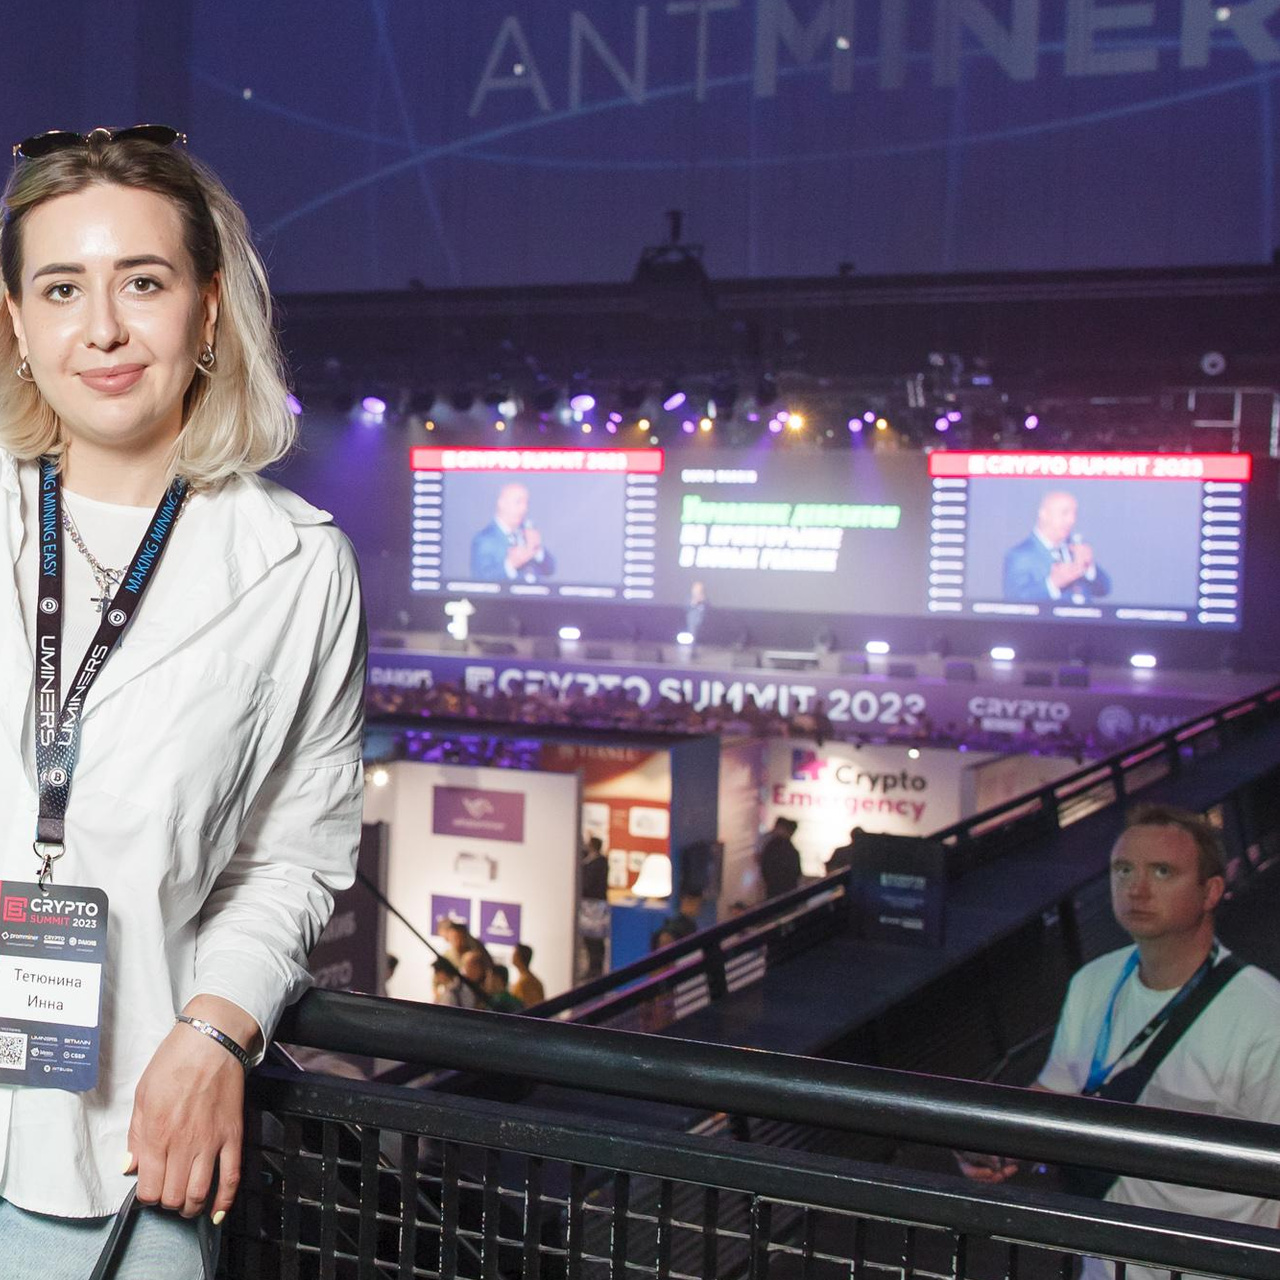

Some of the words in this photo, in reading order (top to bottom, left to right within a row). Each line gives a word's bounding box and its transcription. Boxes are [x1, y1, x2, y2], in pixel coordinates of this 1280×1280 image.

[43, 492, 57, 542] MINING
[43, 544, 57, 577] EASY
[125, 541, 159, 594] MAKING
[40, 635, 56, 747] UMINERS
[58, 644, 109, 747] UMINERS
[827, 689, 927, 725] 2023
[968, 696, 1070, 721] CRYPTO
[836, 766, 928, 793] Crypto
[772, 784, 927, 820] Emgency
[29, 914, 70, 926] SUMMIT
[72, 918, 97, 929] 2023
[30, 898, 98, 917] CRYPTO
[43, 934, 66, 942] CRYPTO
[14, 968, 82, 988] Тетюнина
[27, 994, 64, 1011] Инна
